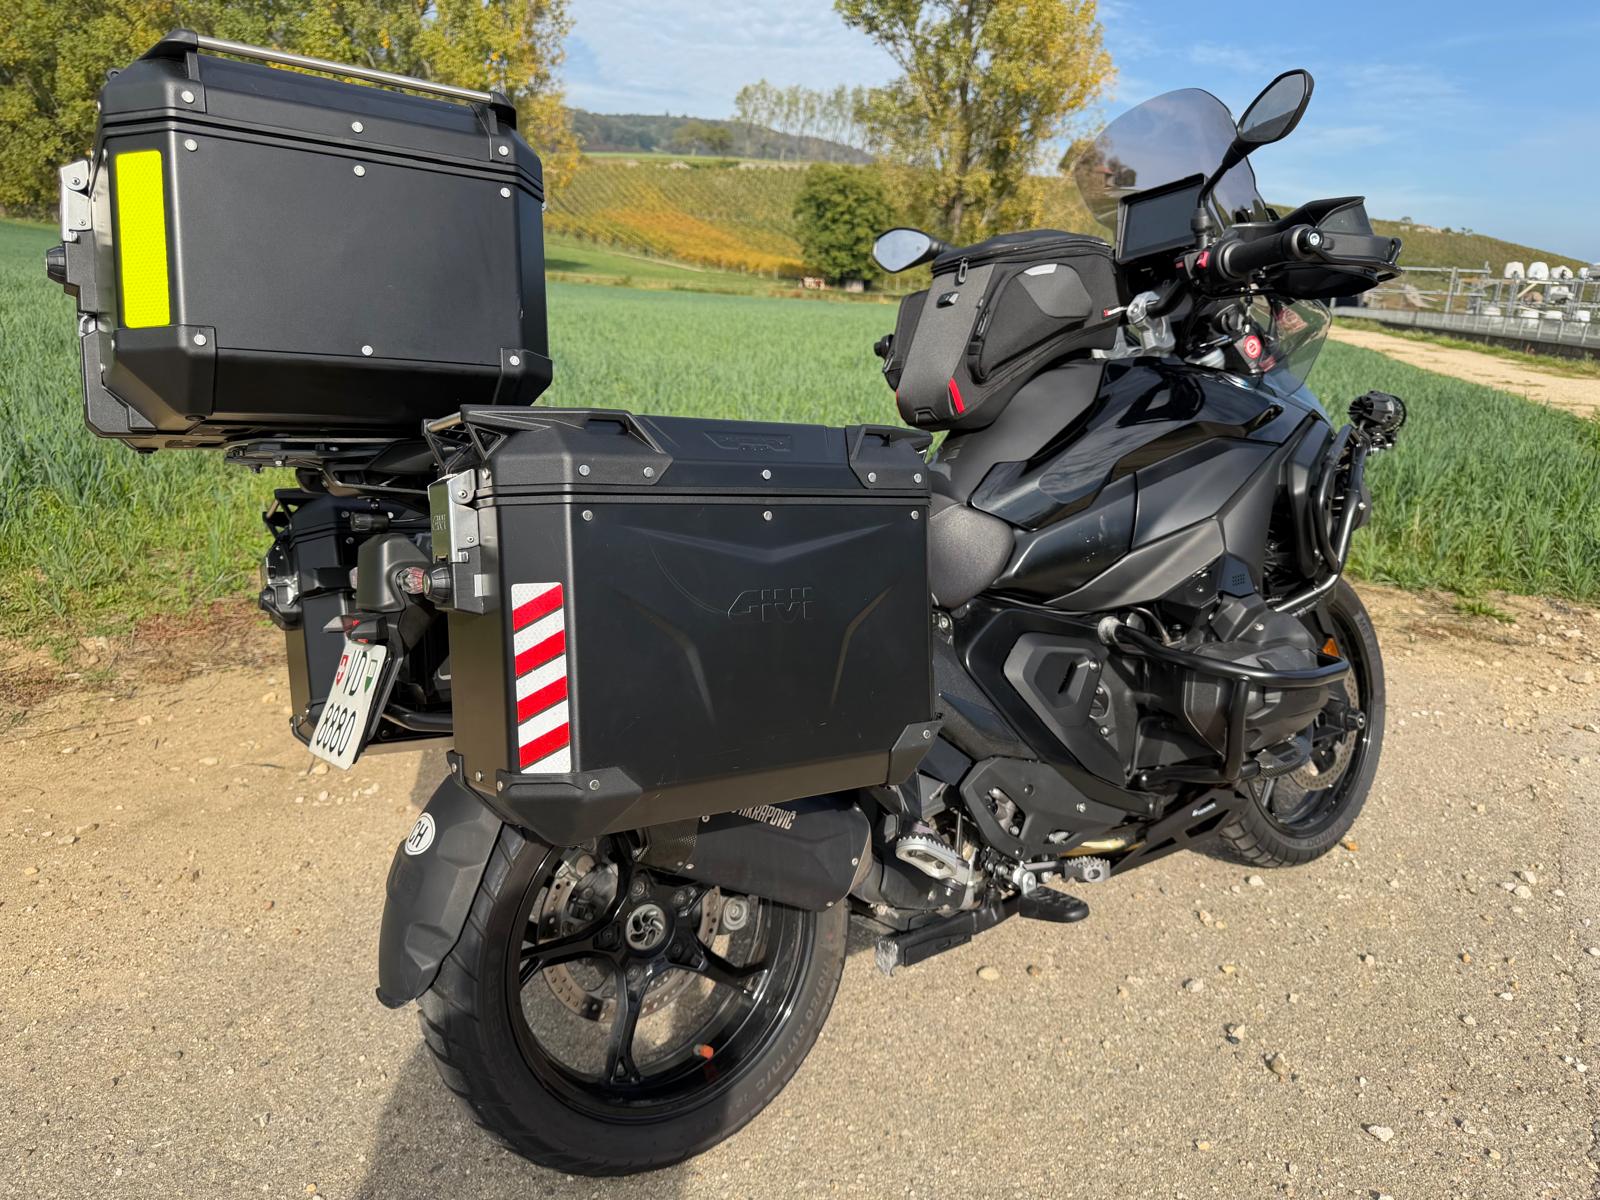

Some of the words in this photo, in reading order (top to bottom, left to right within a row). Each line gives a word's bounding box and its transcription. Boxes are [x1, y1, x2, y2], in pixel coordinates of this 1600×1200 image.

[727, 586, 814, 624] GIVI
[343, 650, 368, 696] VD
[316, 703, 357, 757] 8880
[408, 820, 429, 848] CH
